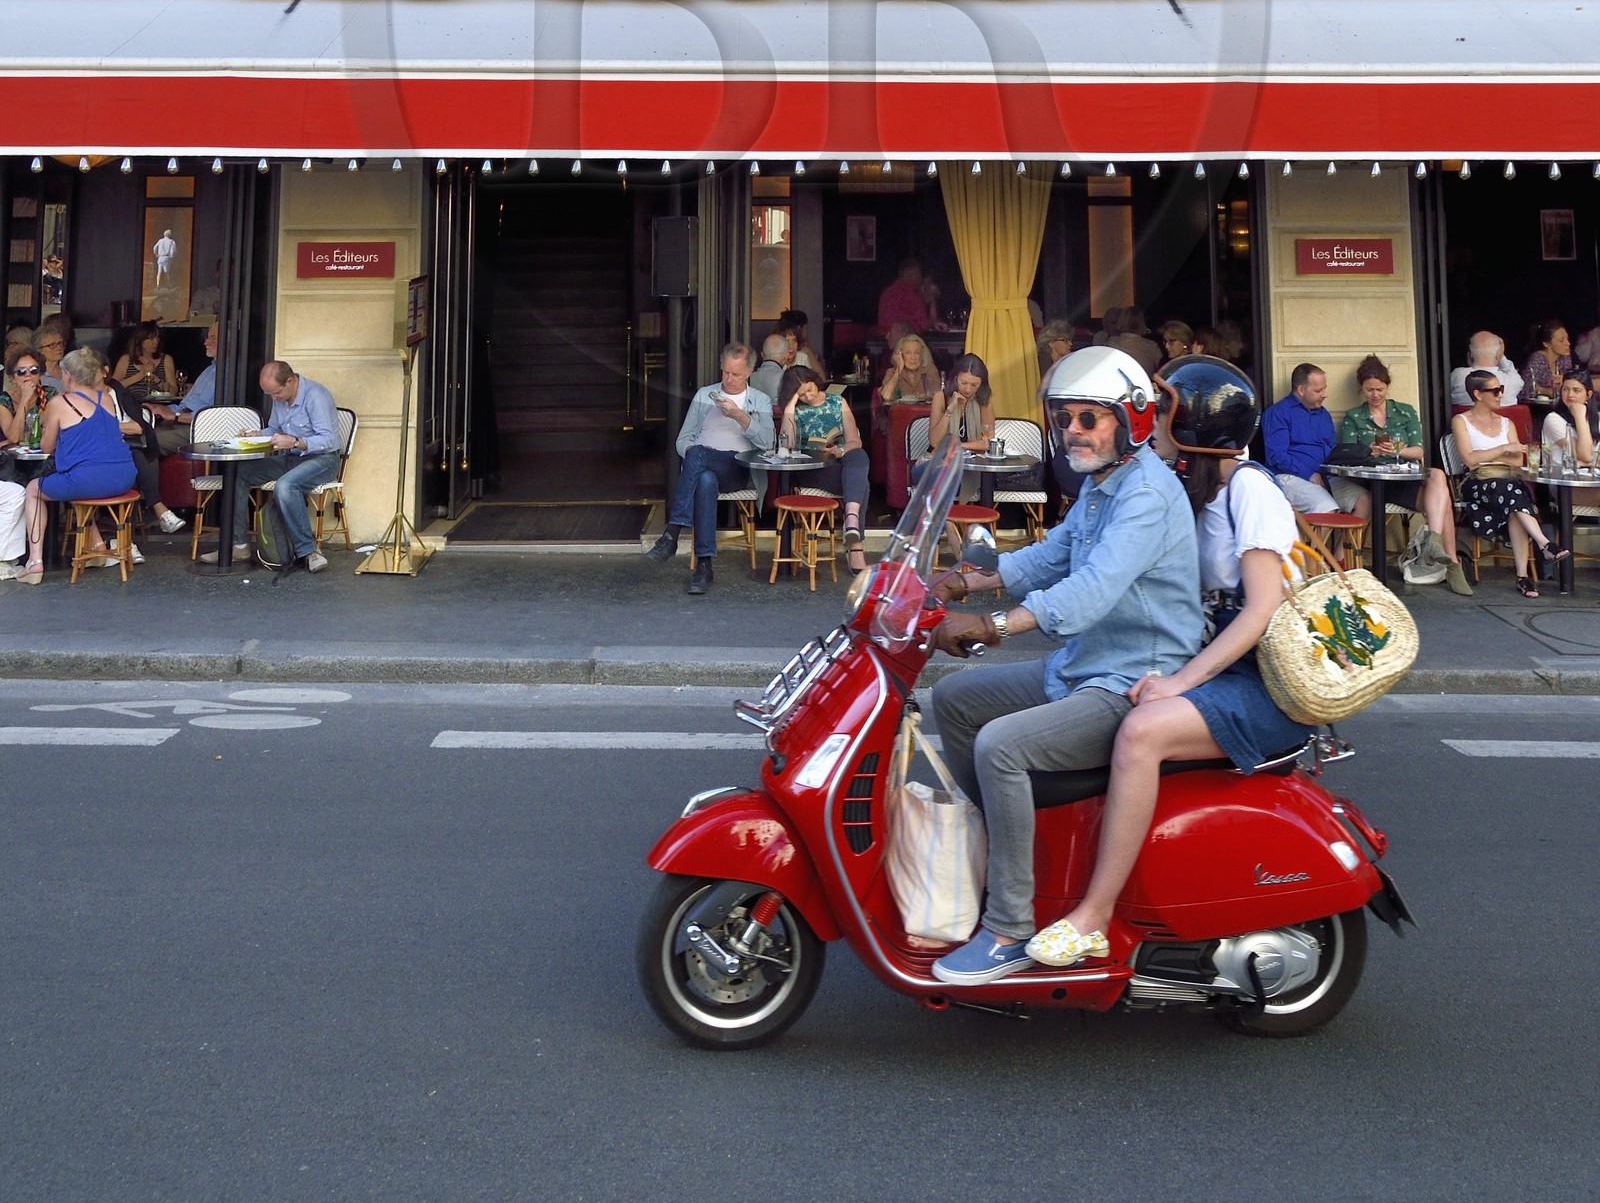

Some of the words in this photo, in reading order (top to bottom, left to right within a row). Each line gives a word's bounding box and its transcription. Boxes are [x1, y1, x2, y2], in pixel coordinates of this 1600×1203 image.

[311, 251, 330, 263] Les
[333, 248, 379, 263] Éditeurs
[1312, 247, 1331, 260] Les
[1333, 244, 1379, 260] Éditeurs
[1254, 863, 1312, 886] Vespa
